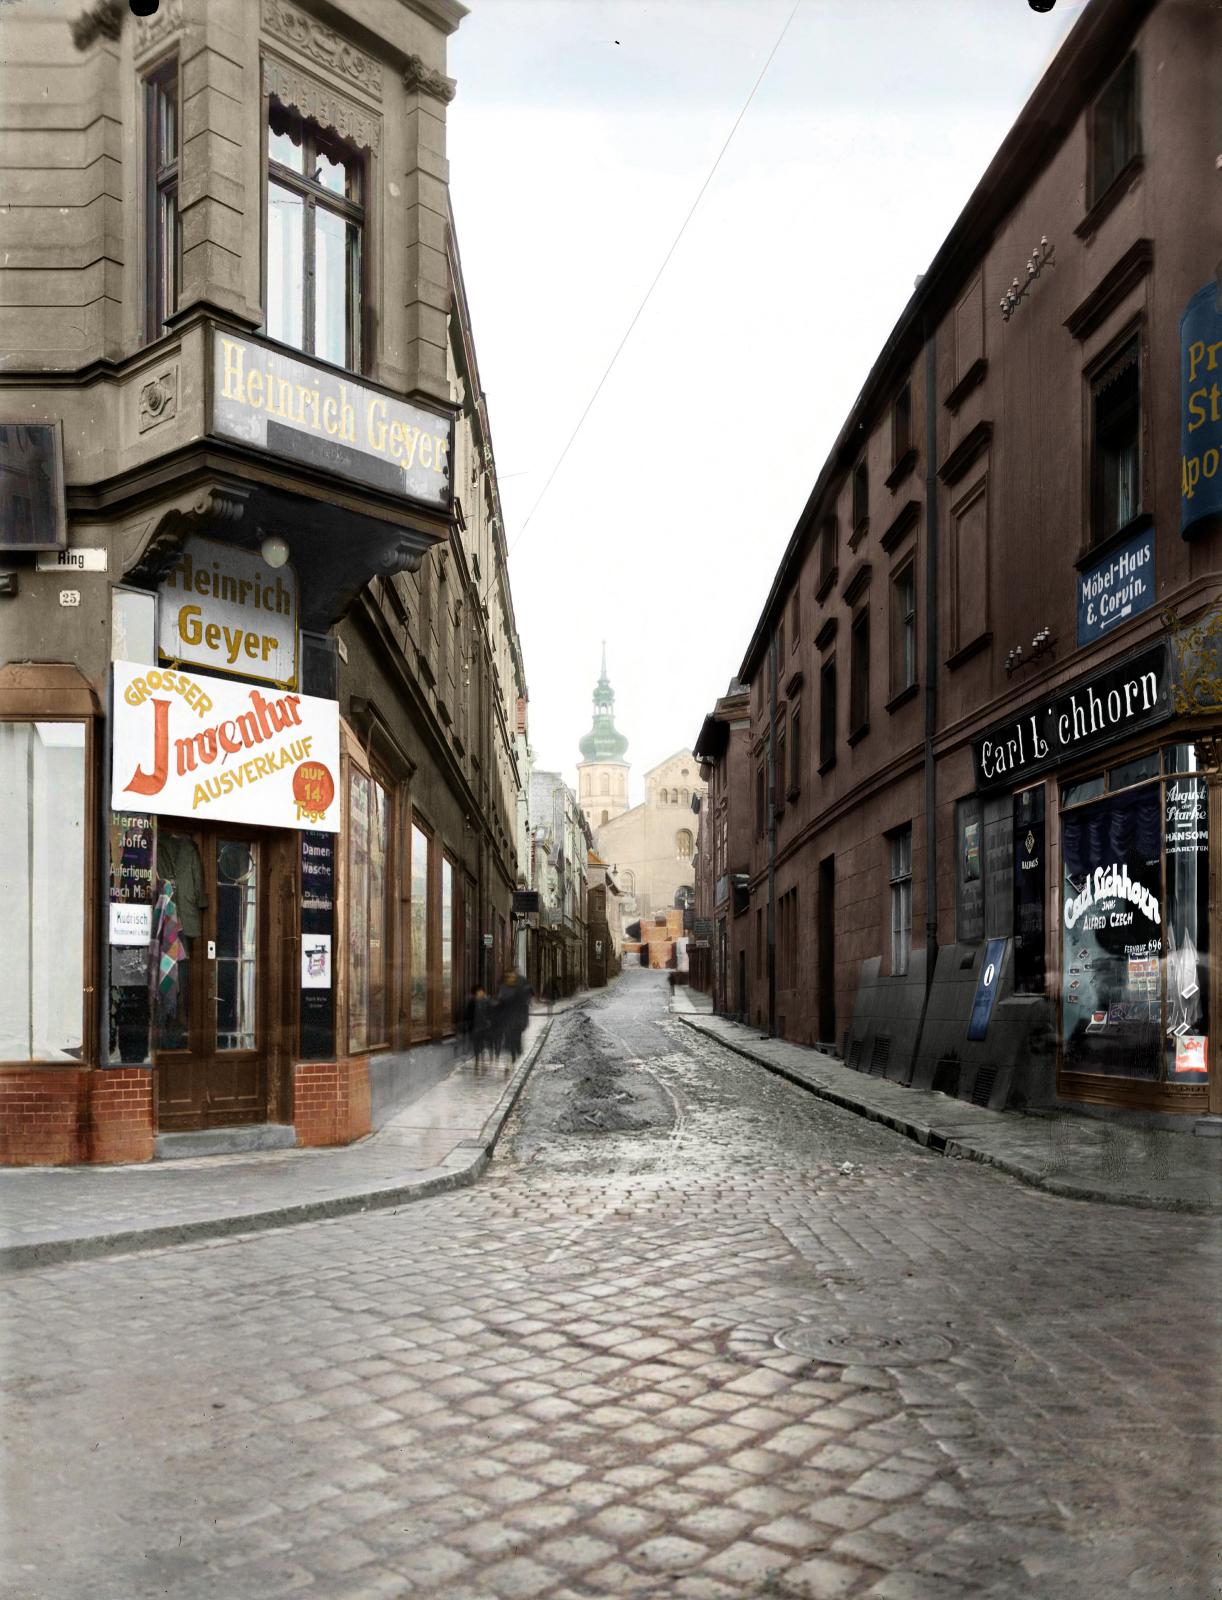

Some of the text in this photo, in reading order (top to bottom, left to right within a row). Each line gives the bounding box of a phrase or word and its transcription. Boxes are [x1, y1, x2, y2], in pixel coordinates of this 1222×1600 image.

[221, 338, 449, 472] Heinrich Geyer
[57, 551, 84, 569] Ring
[167, 553, 291, 616] Heinrich
[1082, 544, 1151, 604] Möbel-Haus
[62, 593, 77, 604] 25
[178, 604, 279, 664] Geyer
[123, 670, 214, 718] GROSSER
[981, 724, 1026, 779] Carl
[192, 736, 313, 810] AUSVERKAUF
[300, 767, 325, 781] nur
[304, 784, 321, 802] 14
[1166, 784, 1207, 804] August
[293, 800, 327, 824] Tage
[109, 884, 130, 898] nach
[1083, 912, 1134, 931] ALFRED CZECH
[1147, 938, 1162, 953] 696
